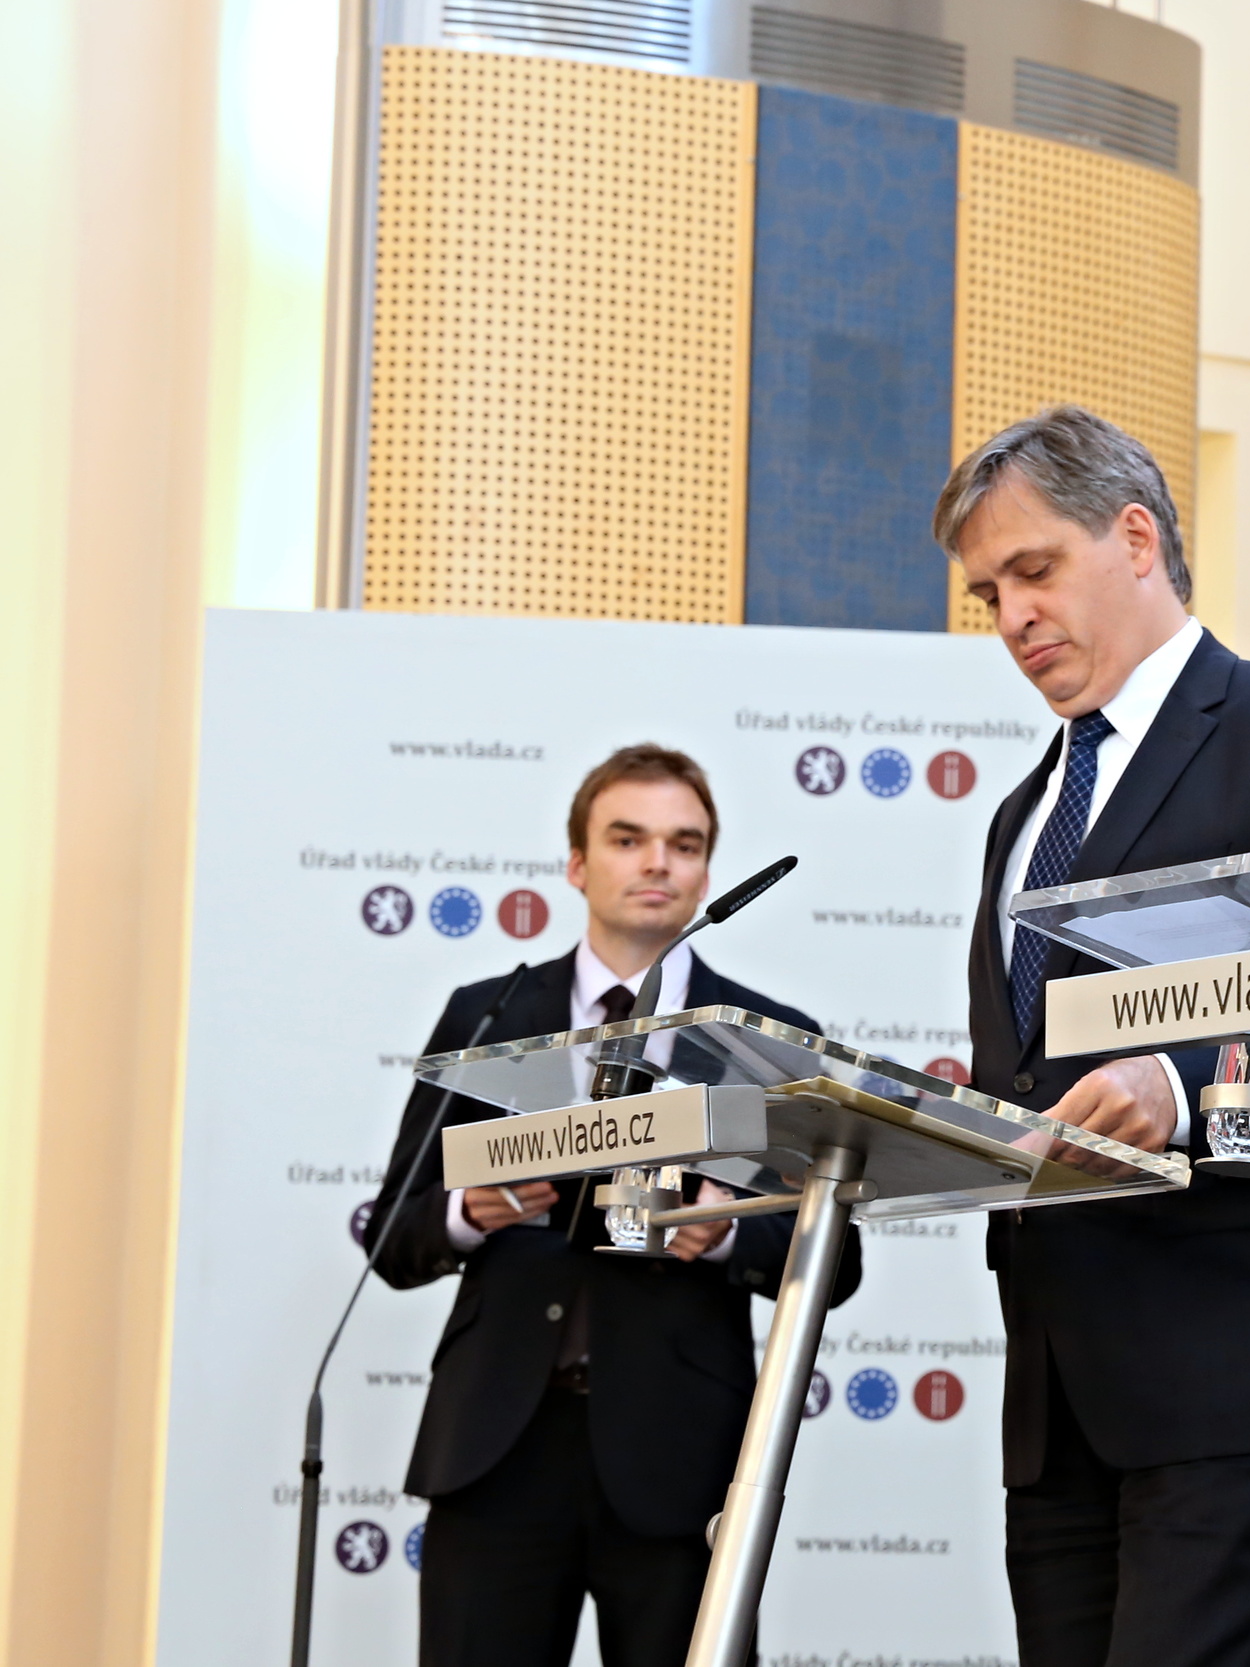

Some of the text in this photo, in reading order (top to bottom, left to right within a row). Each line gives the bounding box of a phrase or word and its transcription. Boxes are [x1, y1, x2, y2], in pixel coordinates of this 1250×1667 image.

[734, 708, 1039, 743] Úřad vlády České republiky
[389, 738, 545, 761] www.vlada.cz
[300, 845, 357, 871] Úřad
[363, 850, 423, 875] vlády
[429, 849, 497, 874] České
[811, 906, 963, 930] www.vlada.cz
[487, 1110, 655, 1168] www.vlada.cz
[287, 1160, 344, 1185] Úřad
[846, 1331, 911, 1356] České
[796, 1535, 951, 1556] www.vlada.cz
